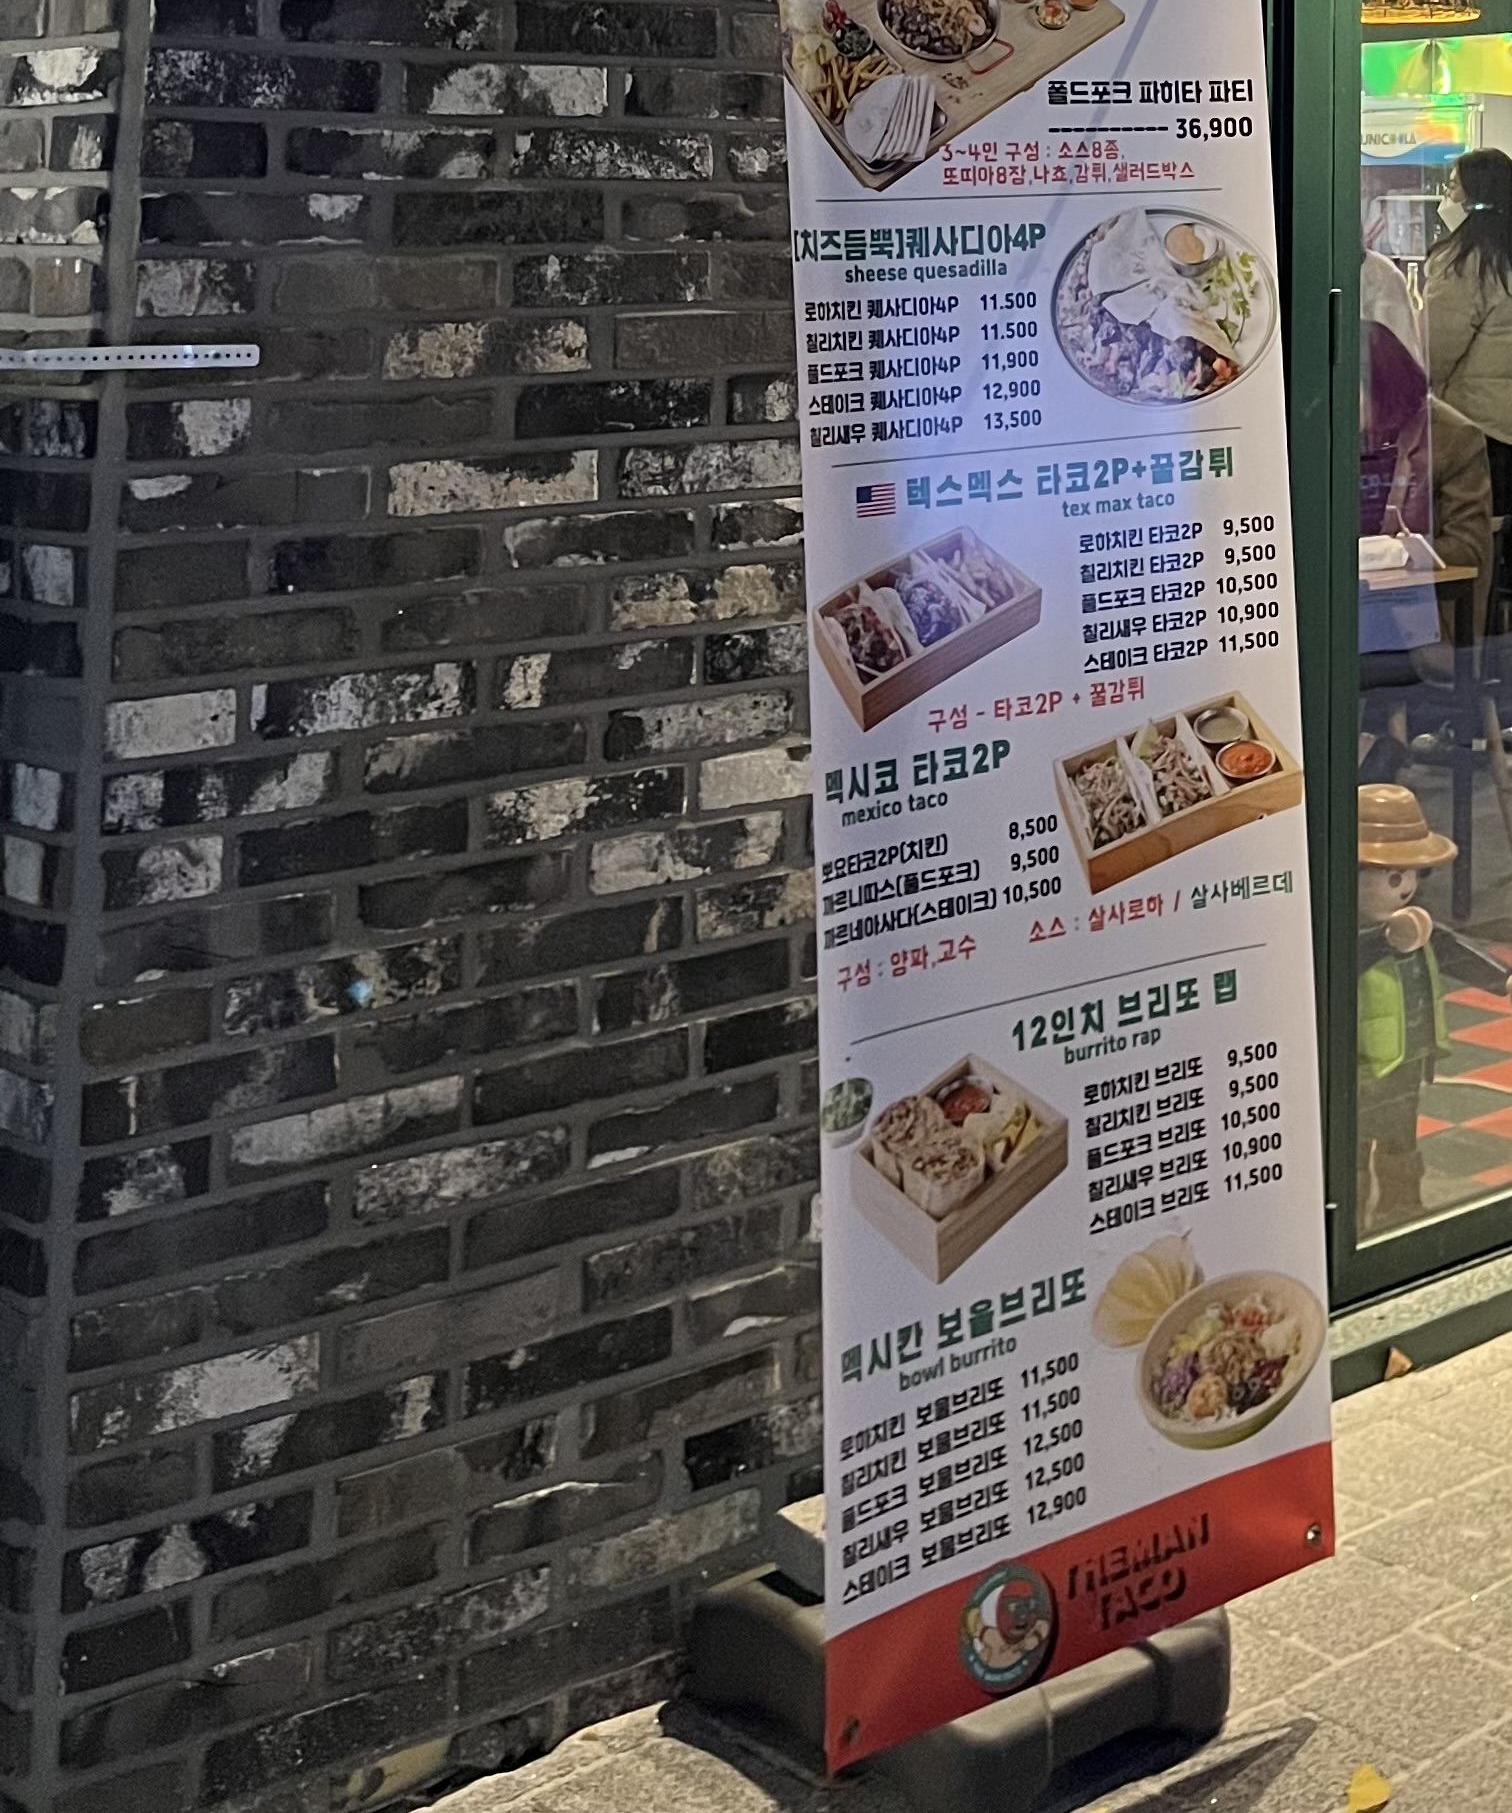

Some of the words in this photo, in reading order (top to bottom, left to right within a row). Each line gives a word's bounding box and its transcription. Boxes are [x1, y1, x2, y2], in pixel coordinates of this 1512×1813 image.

[1139, 79, 1202, 104] 파히타
[1209, 78, 1254, 103] 파티
[1175, 116, 1253, 141] 36,900
[1005, 141, 1040, 160] 구성
[845, 264, 907, 283] sheese
[914, 259, 1007, 282] quesadilla
[982, 350, 1039, 372] 11,900
[809, 392, 864, 415] 스테이크
[983, 380, 1041, 400] 12,900
[983, 409, 1042, 431] 13,500
[905, 469, 1024, 510] 텍스멕스
[1062, 500, 1091, 518] tex
[1095, 496, 1132, 515] max
[1136, 491, 1176, 511] taco
[1148, 522, 1203, 545] 타코2P
[1222, 515, 1276, 538] 9,500
[1080, 556, 1145, 583] 칠리치킨
[1150, 551, 1204, 574] 타코2P
[1224, 543, 1276, 566] 9,500
[1151, 580, 1206, 604] 타코2P
[1215, 572, 1278, 597] 10,500
[1152, 610, 1207, 634] 타코2P
[1217, 601, 1280, 626] 10,900
[1084, 645, 1148, 674] 스테이크
[1153, 638, 1209, 663] 타코2P
[1218, 630, 1280, 656] 11,500
[928, 707, 968, 733] 구성
[993, 691, 1063, 722] 타코2P
[825, 758, 899, 804] 멕시코
[913, 739, 1011, 787] 타코2P
[842, 800, 901, 828] mexico
[908, 792, 948, 812] taco
[1009, 814, 1058, 841] 8,500
[1011, 846, 1059, 873] 9,500
[1002, 876, 1062, 905] 10,500
[838, 959, 871, 992] 구성
[1029, 916, 1067, 943] 소스
[1191, 870, 1294, 910] 살사베르데
[1011, 999, 1104, 1052] 12인치
[1118, 977, 1200, 1028] 브리또
[1064, 1035, 1128, 1065] burrito
[1131, 1027, 1162, 1048] rap
[1155, 1056, 1204, 1087] 브리또
[1227, 1041, 1278, 1068] 9,500
[1156, 1087, 1206, 1118] 브리또
[1229, 1071, 1279, 1099] 9,500
[1158, 1118, 1208, 1149] 브리또
[1221, 1102, 1281, 1131] 10,500
[1159, 1148, 1209, 1181] 브리또
[1222, 1132, 1282, 1162] 10,900
[1089, 1196, 1156, 1235] 스테이크
[1161, 1180, 1211, 1213] 브리또
[1224, 1163, 1284, 1194] 11,500
[841, 1321, 923, 1383] 멕시칸
[899, 1359, 944, 1392] bowl
[950, 1337, 1017, 1374] burrito
[1021, 1352, 1079, 1388] 11,500
[1022, 1386, 1081, 1422] 11,500
[1023, 1419, 1084, 1456] 12,500
[1025, 1452, 1085, 1490] 12,500
[1027, 1486, 1087, 1525] 12,900
